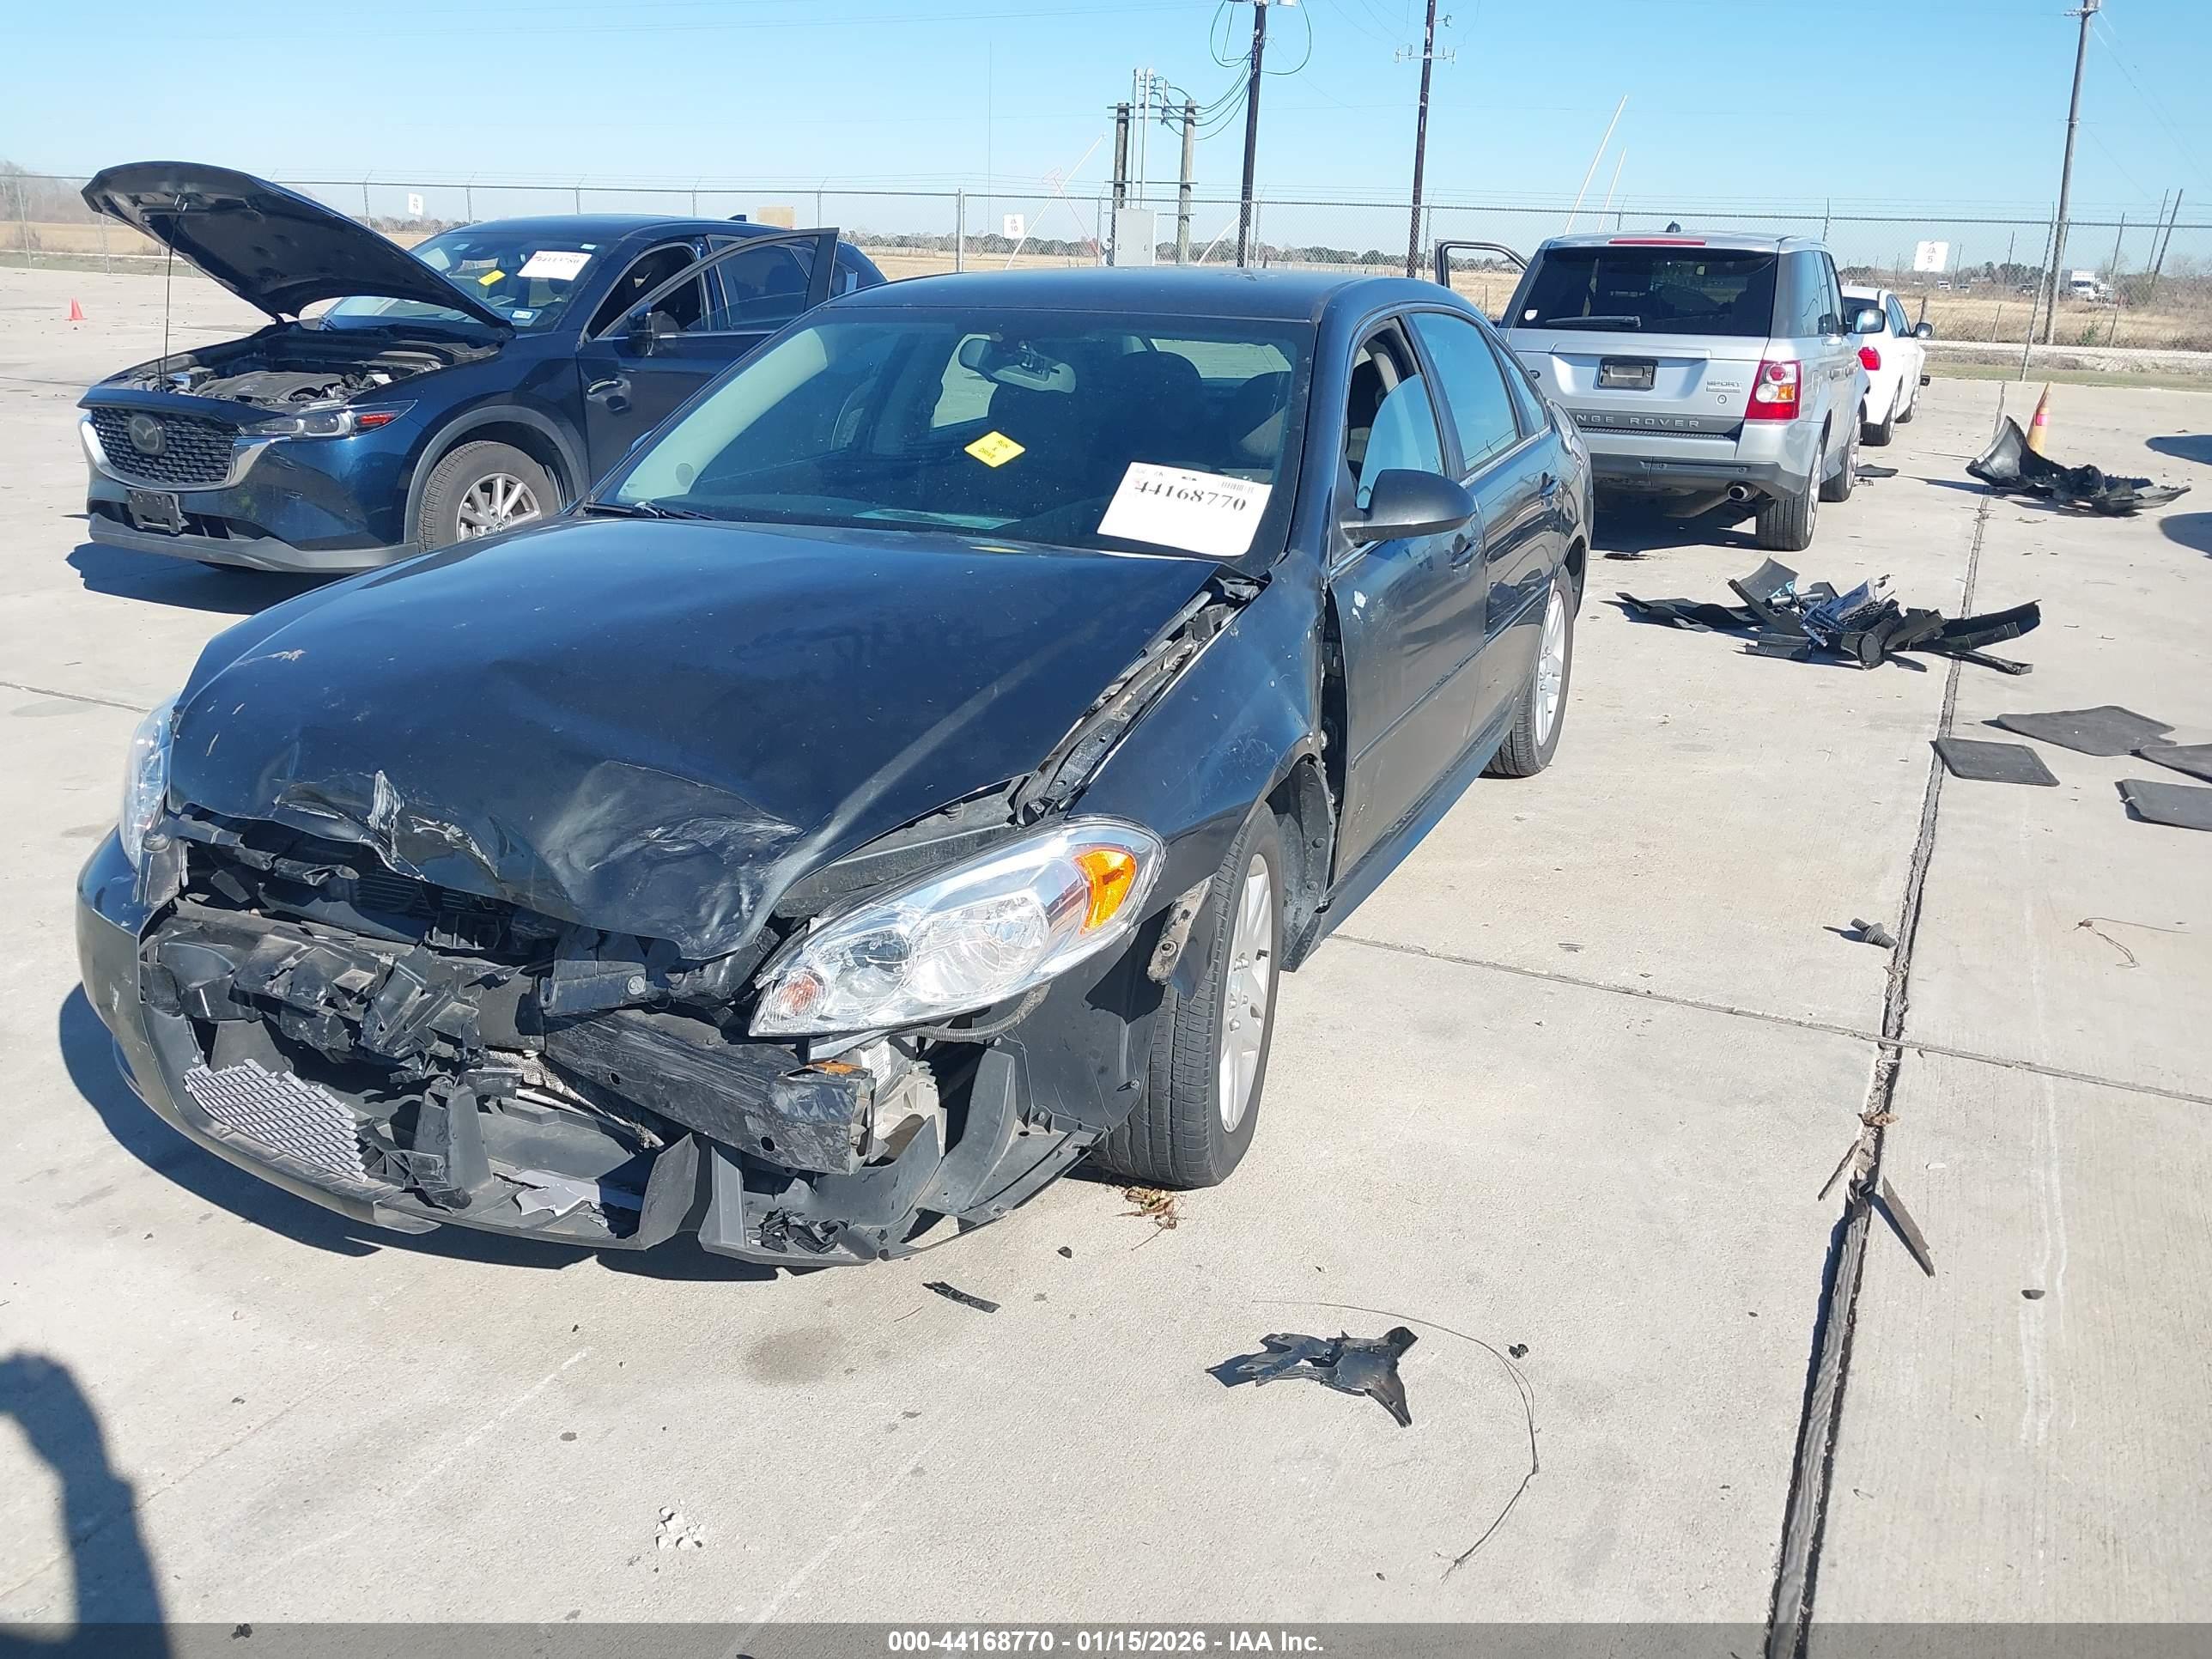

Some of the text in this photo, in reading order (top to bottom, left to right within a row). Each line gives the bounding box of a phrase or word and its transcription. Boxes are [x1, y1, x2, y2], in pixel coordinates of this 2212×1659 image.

[1927, 255, 1933, 264] 5
[1575, 414, 1700, 428] NGE ROVER
[1134, 481, 1247, 512] 44168770
